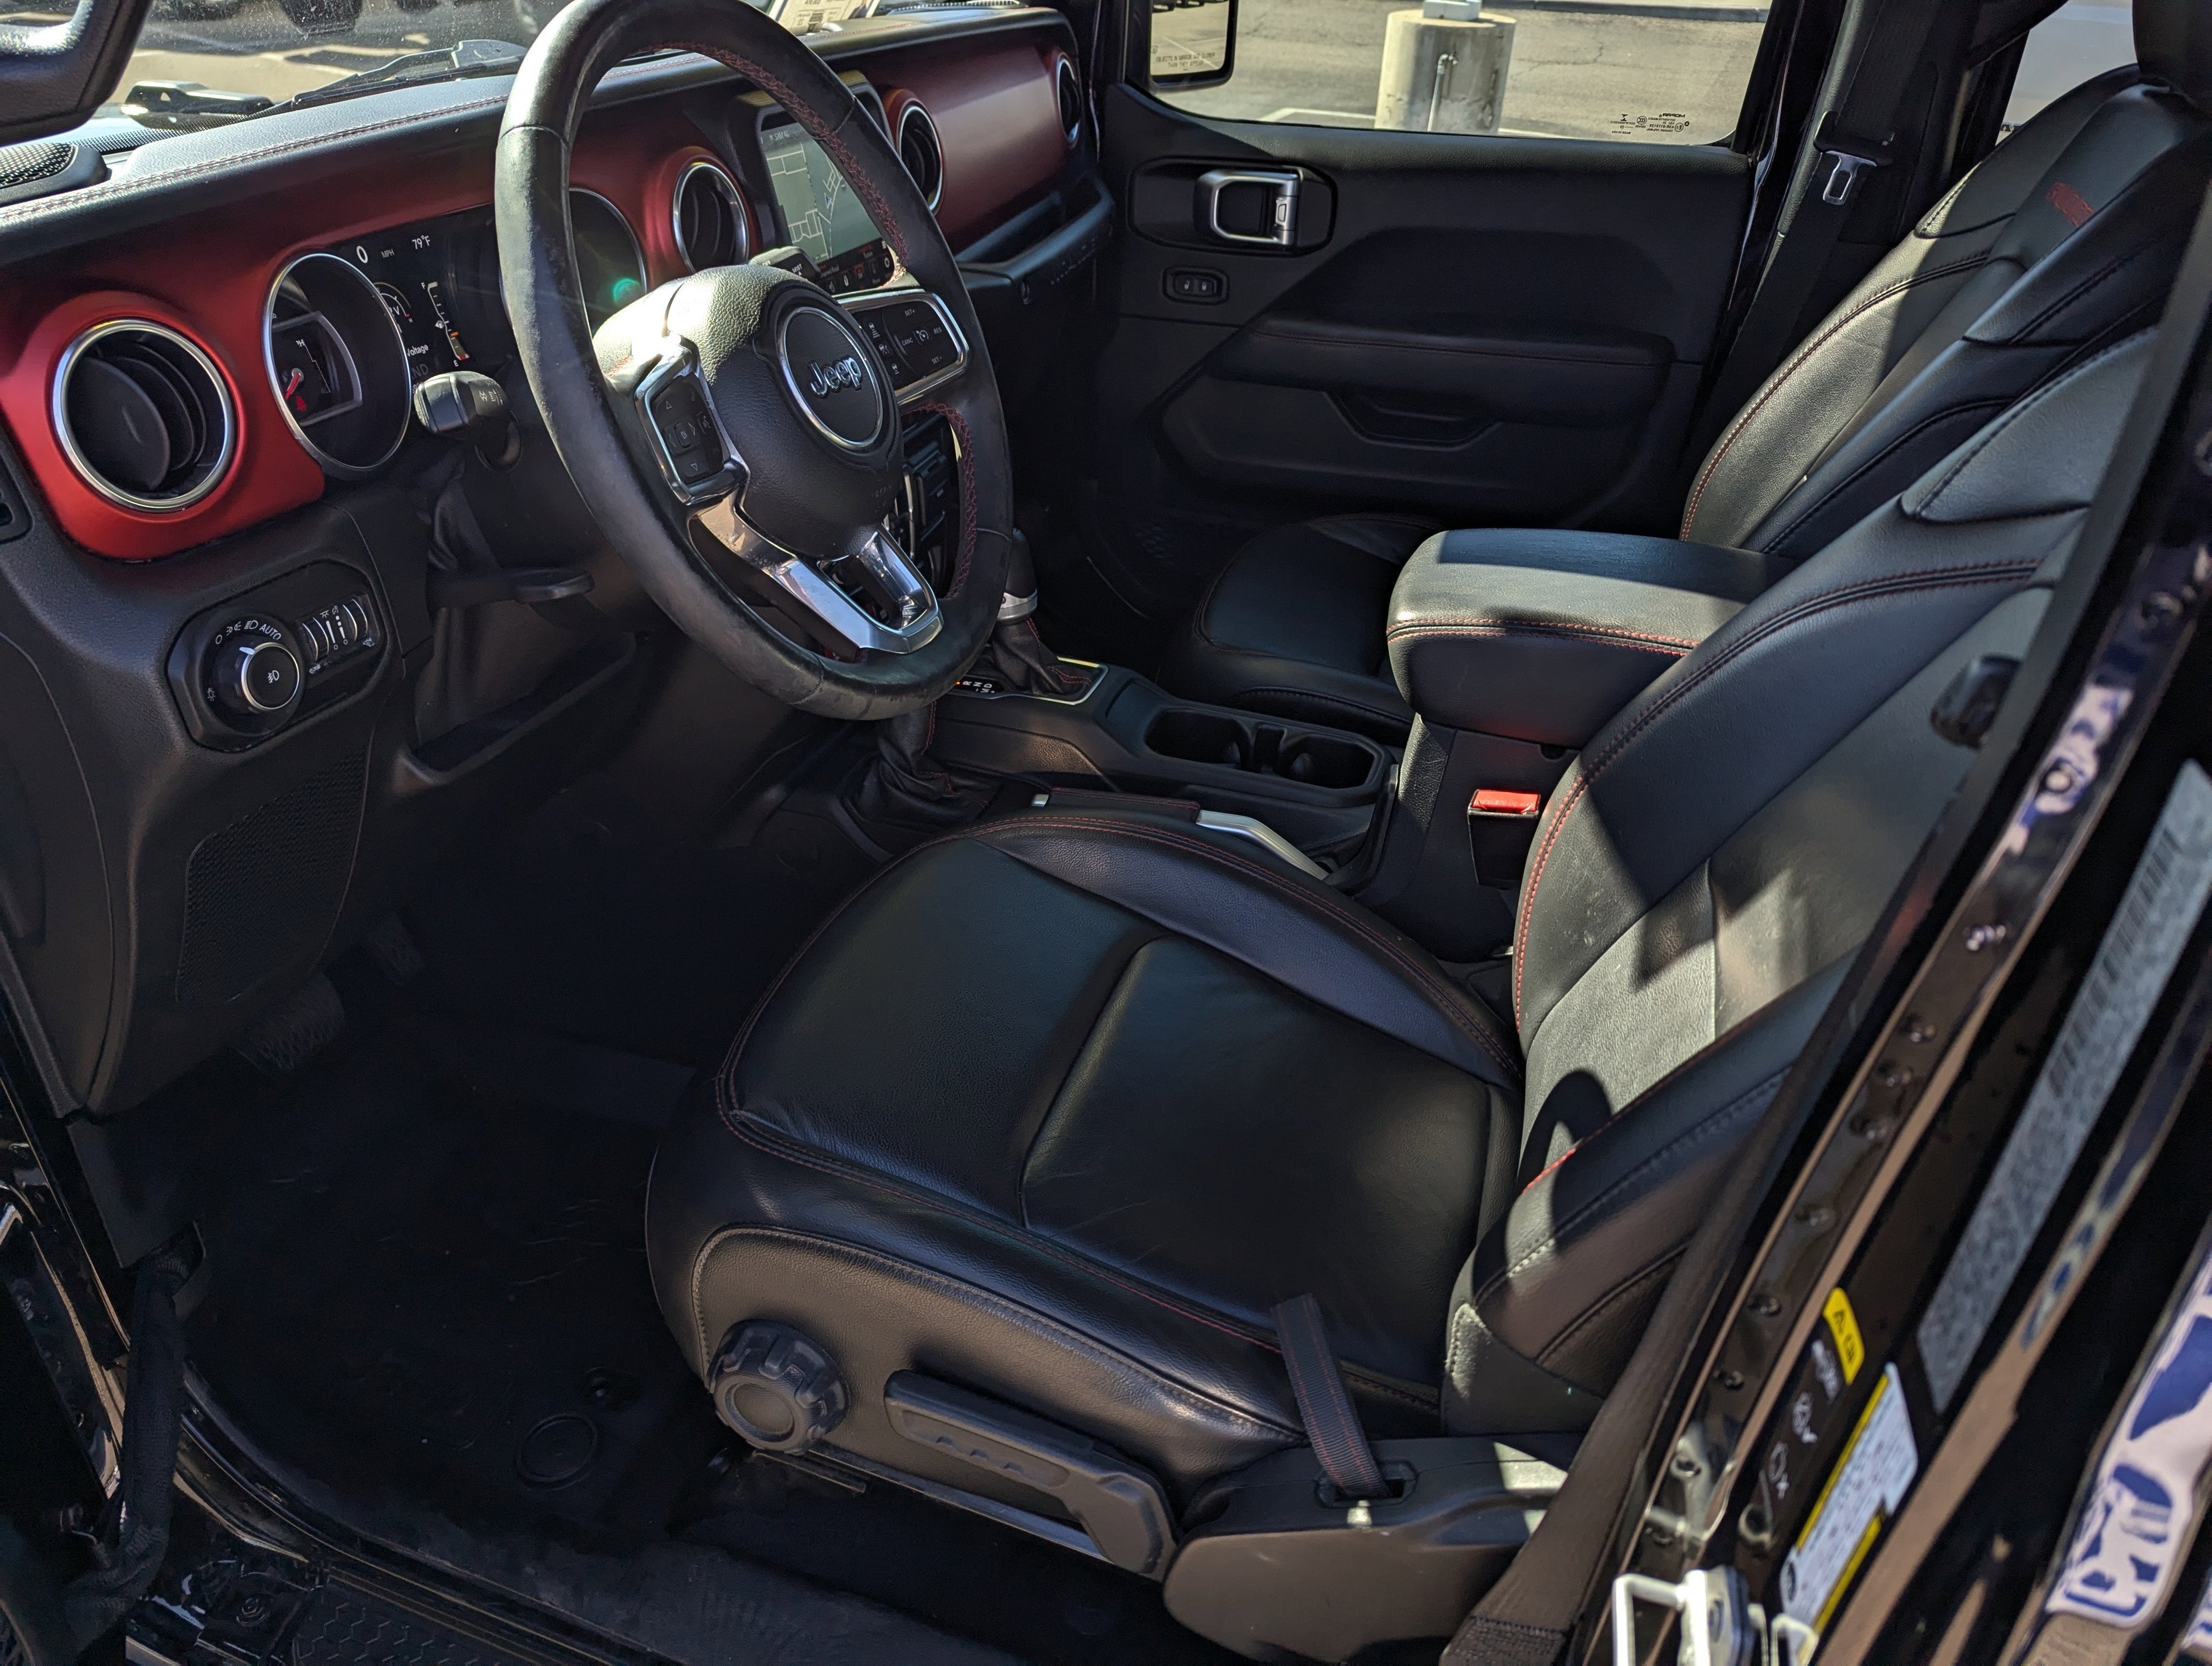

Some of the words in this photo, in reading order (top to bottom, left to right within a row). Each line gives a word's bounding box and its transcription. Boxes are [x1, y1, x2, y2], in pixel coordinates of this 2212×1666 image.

[356, 246, 368, 264] 0
[381, 248, 395, 259] MPH
[902, 337, 914, 346] CANC
[809, 356, 861, 396] Jeep
[259, 623, 281, 640] AUTO
